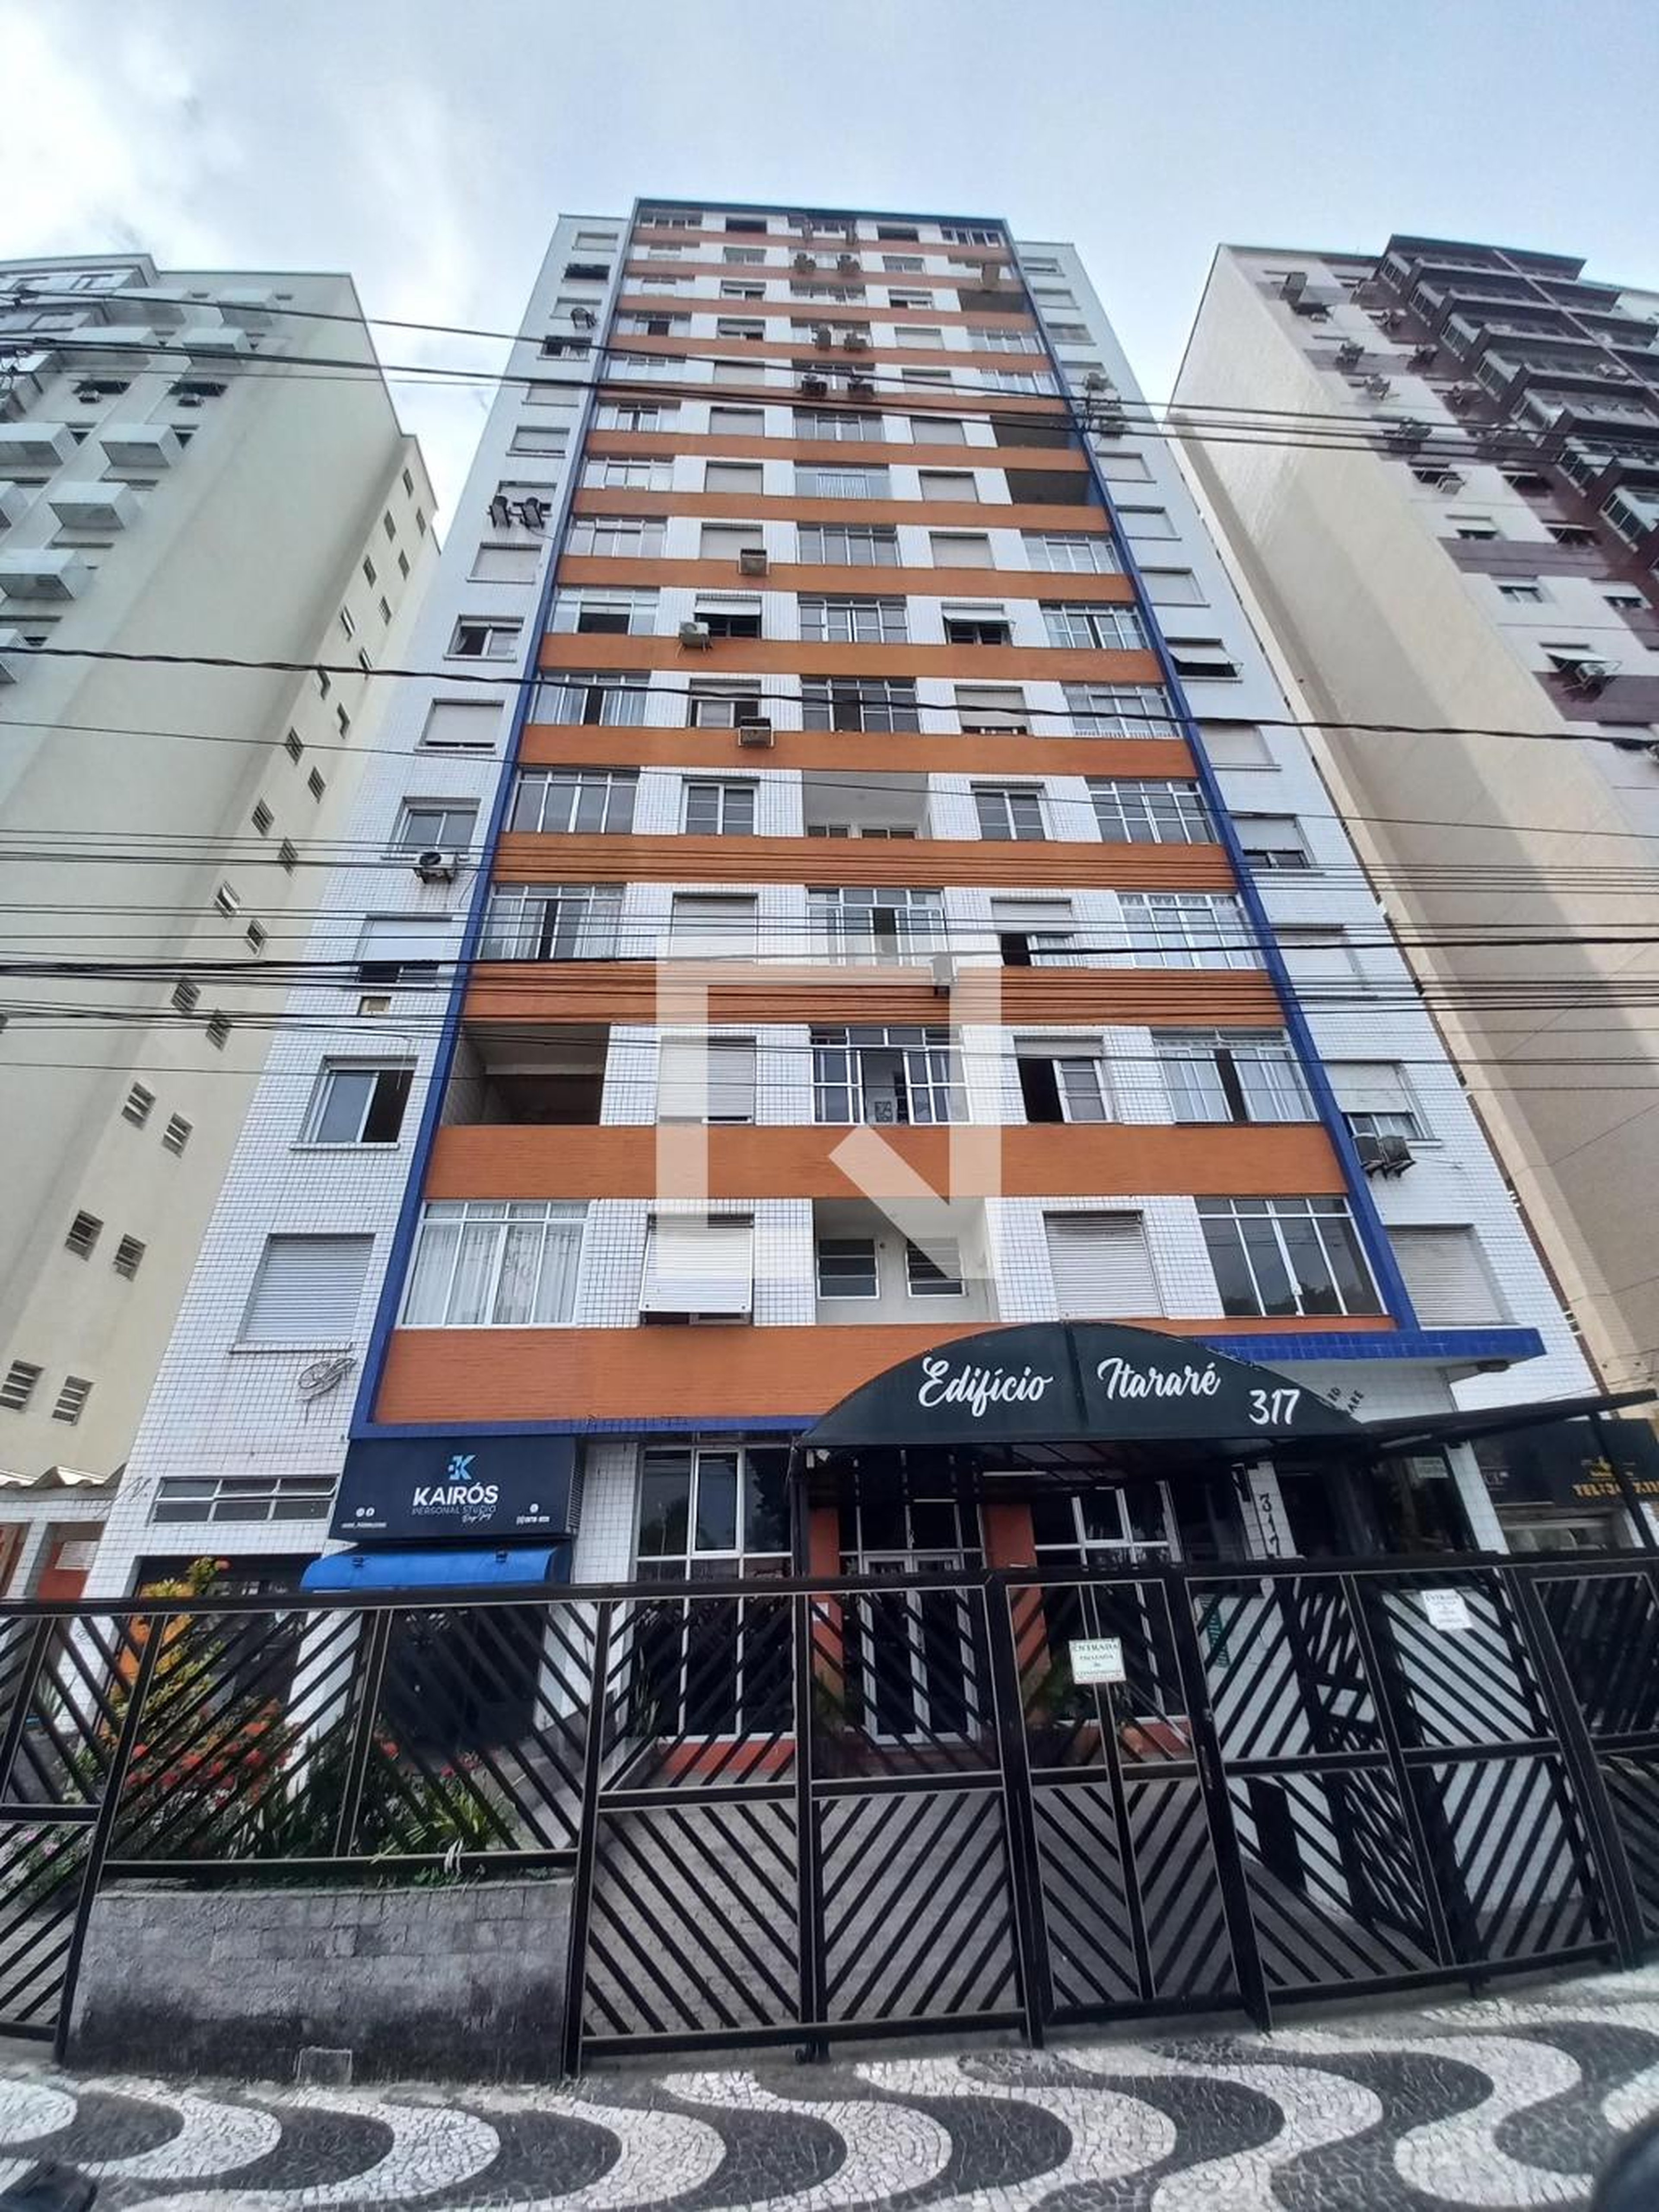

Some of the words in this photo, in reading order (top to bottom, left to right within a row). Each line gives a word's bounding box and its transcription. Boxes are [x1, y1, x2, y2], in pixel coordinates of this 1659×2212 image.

[918, 1356, 1053, 1417] Edifício
[1097, 1357, 1220, 1400] Itararé
[1249, 1388, 1300, 1425] 317
[412, 1506, 460, 1515] PERSONAL
[463, 1505, 497, 1514] STUDIO
[413, 1482, 499, 1506] KAIRÓS
[1260, 1493, 1281, 1556] 317
